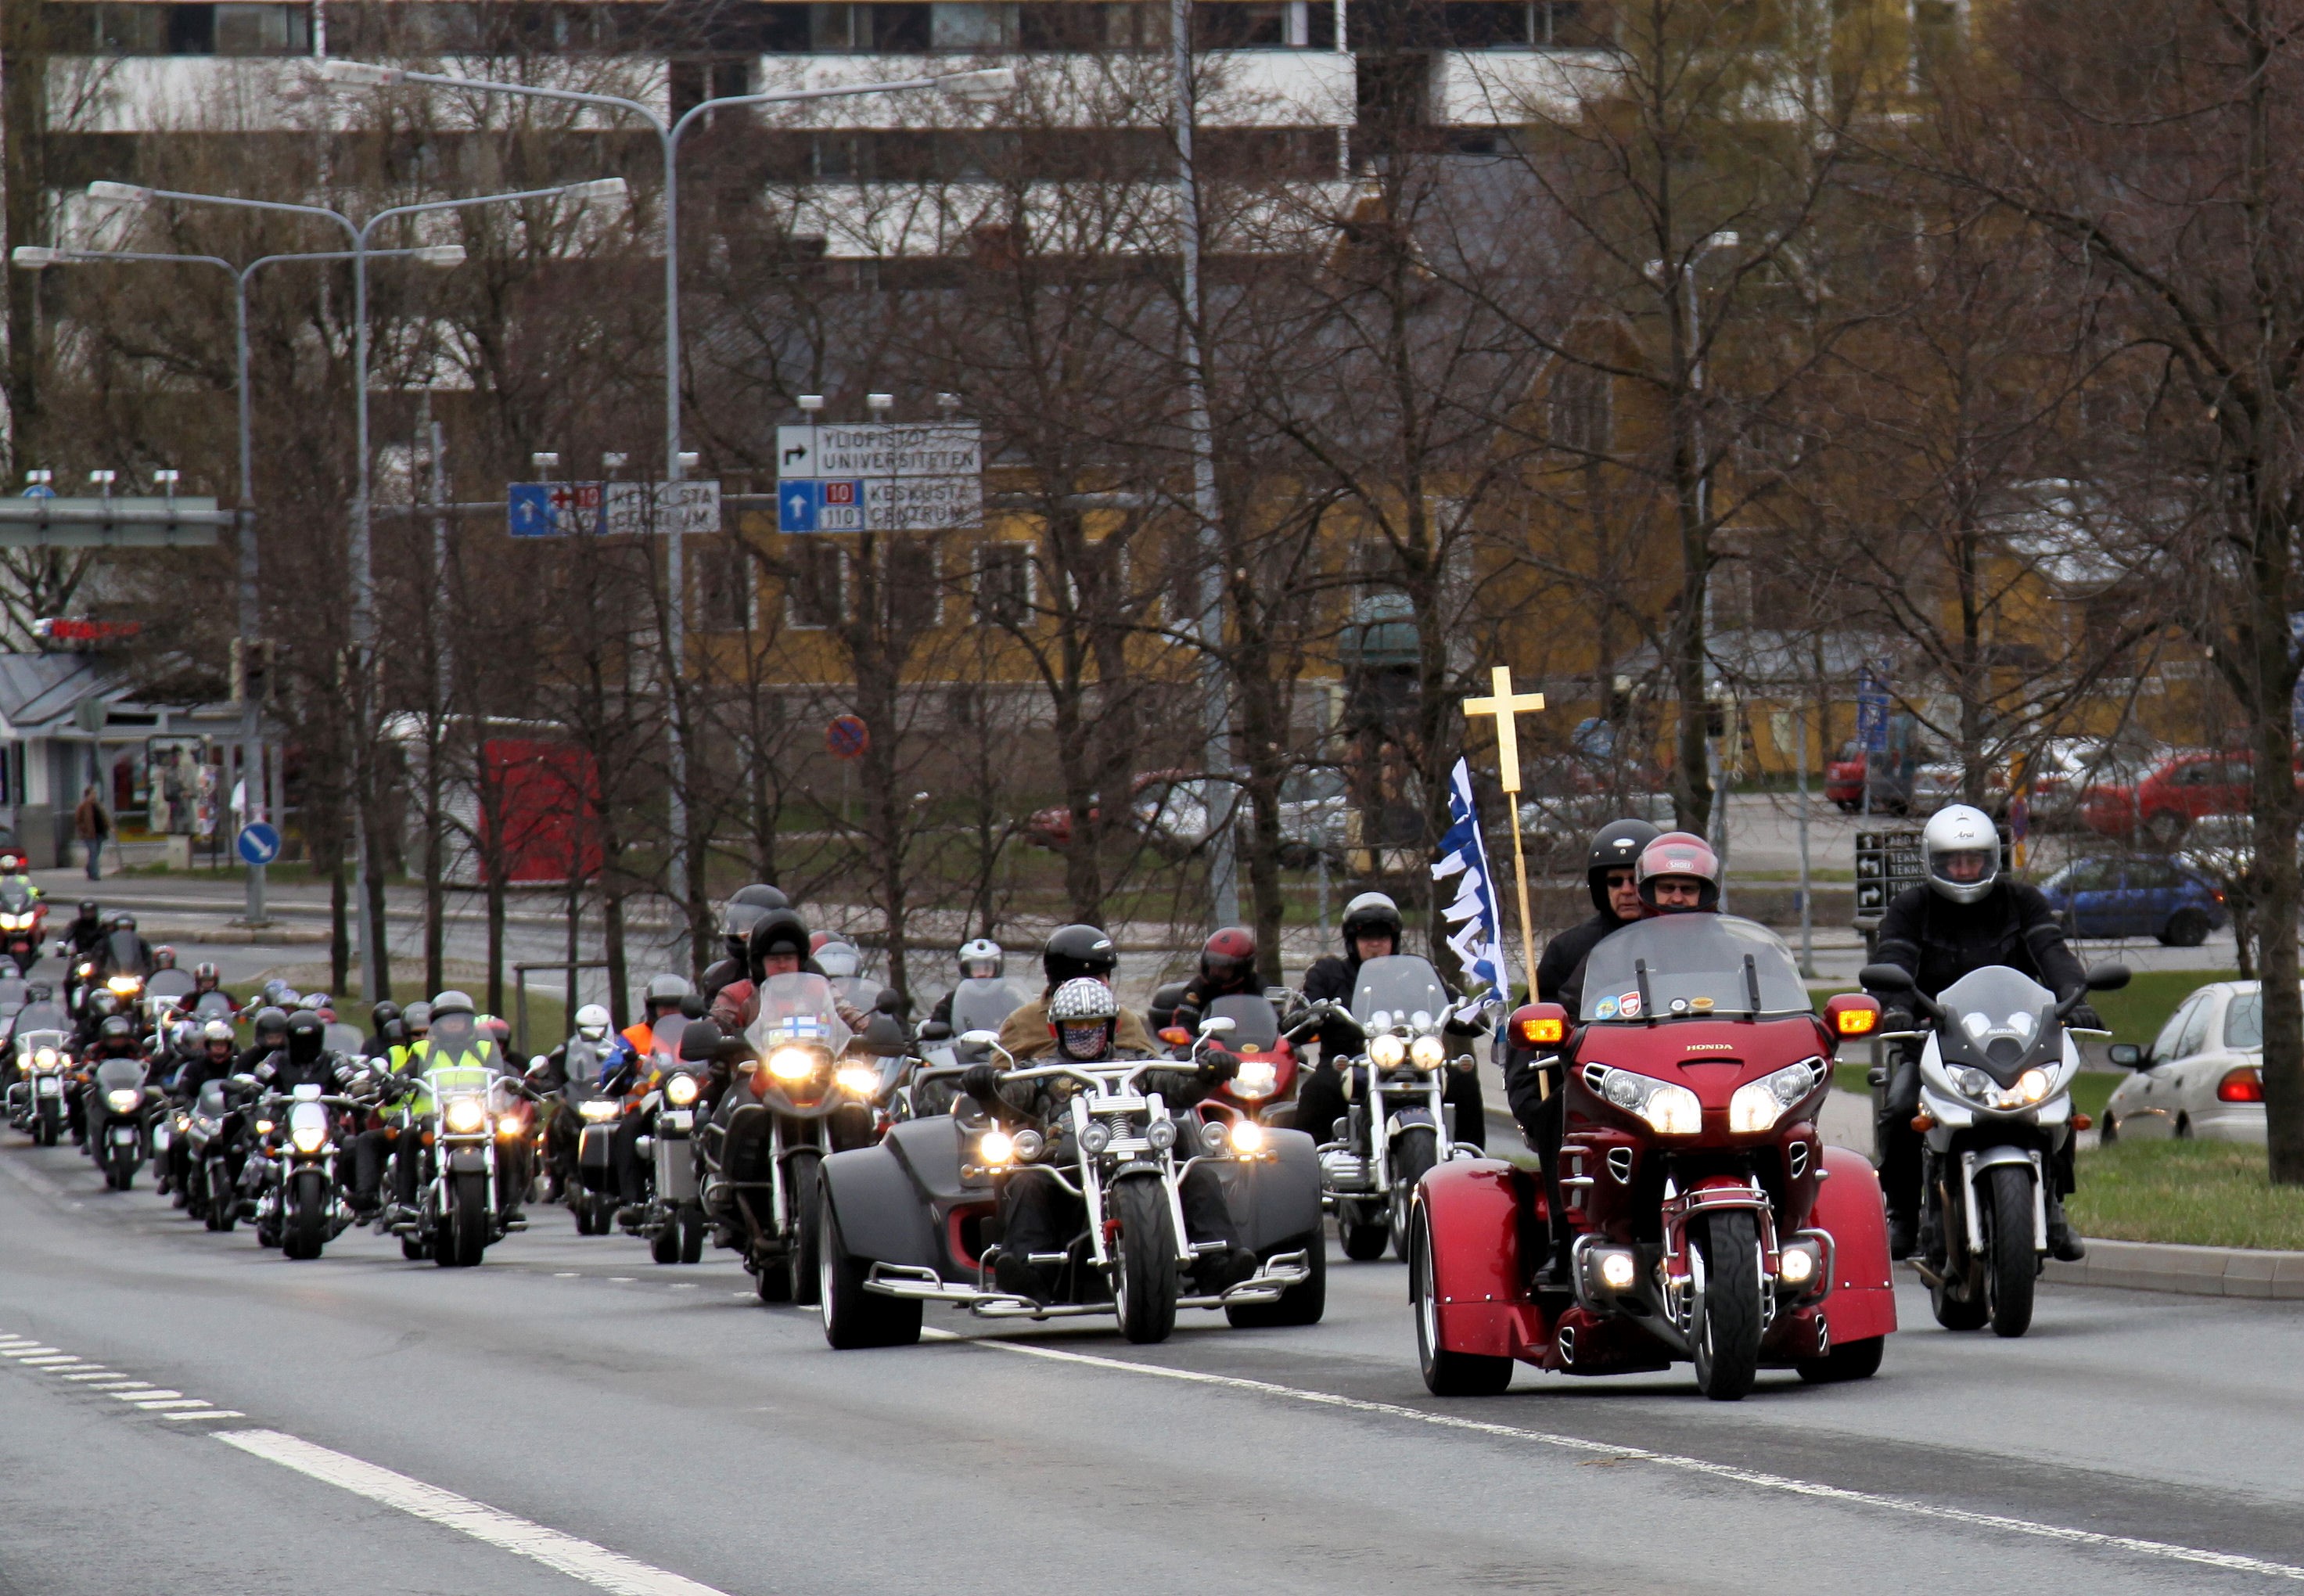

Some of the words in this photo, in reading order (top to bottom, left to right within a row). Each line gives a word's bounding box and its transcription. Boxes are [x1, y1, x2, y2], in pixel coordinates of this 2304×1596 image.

[825, 450, 975, 469] UNIVERSITETEN
[831, 484, 849, 500] 10
[870, 484, 969, 502] KESKUSTA
[826, 509, 854, 524] 110
[871, 506, 965, 523] CENTRUM
[1954, 830, 1975, 839] Arai
[1890, 881, 1924, 893] TUR
[1687, 1043, 1734, 1051] HONDA
